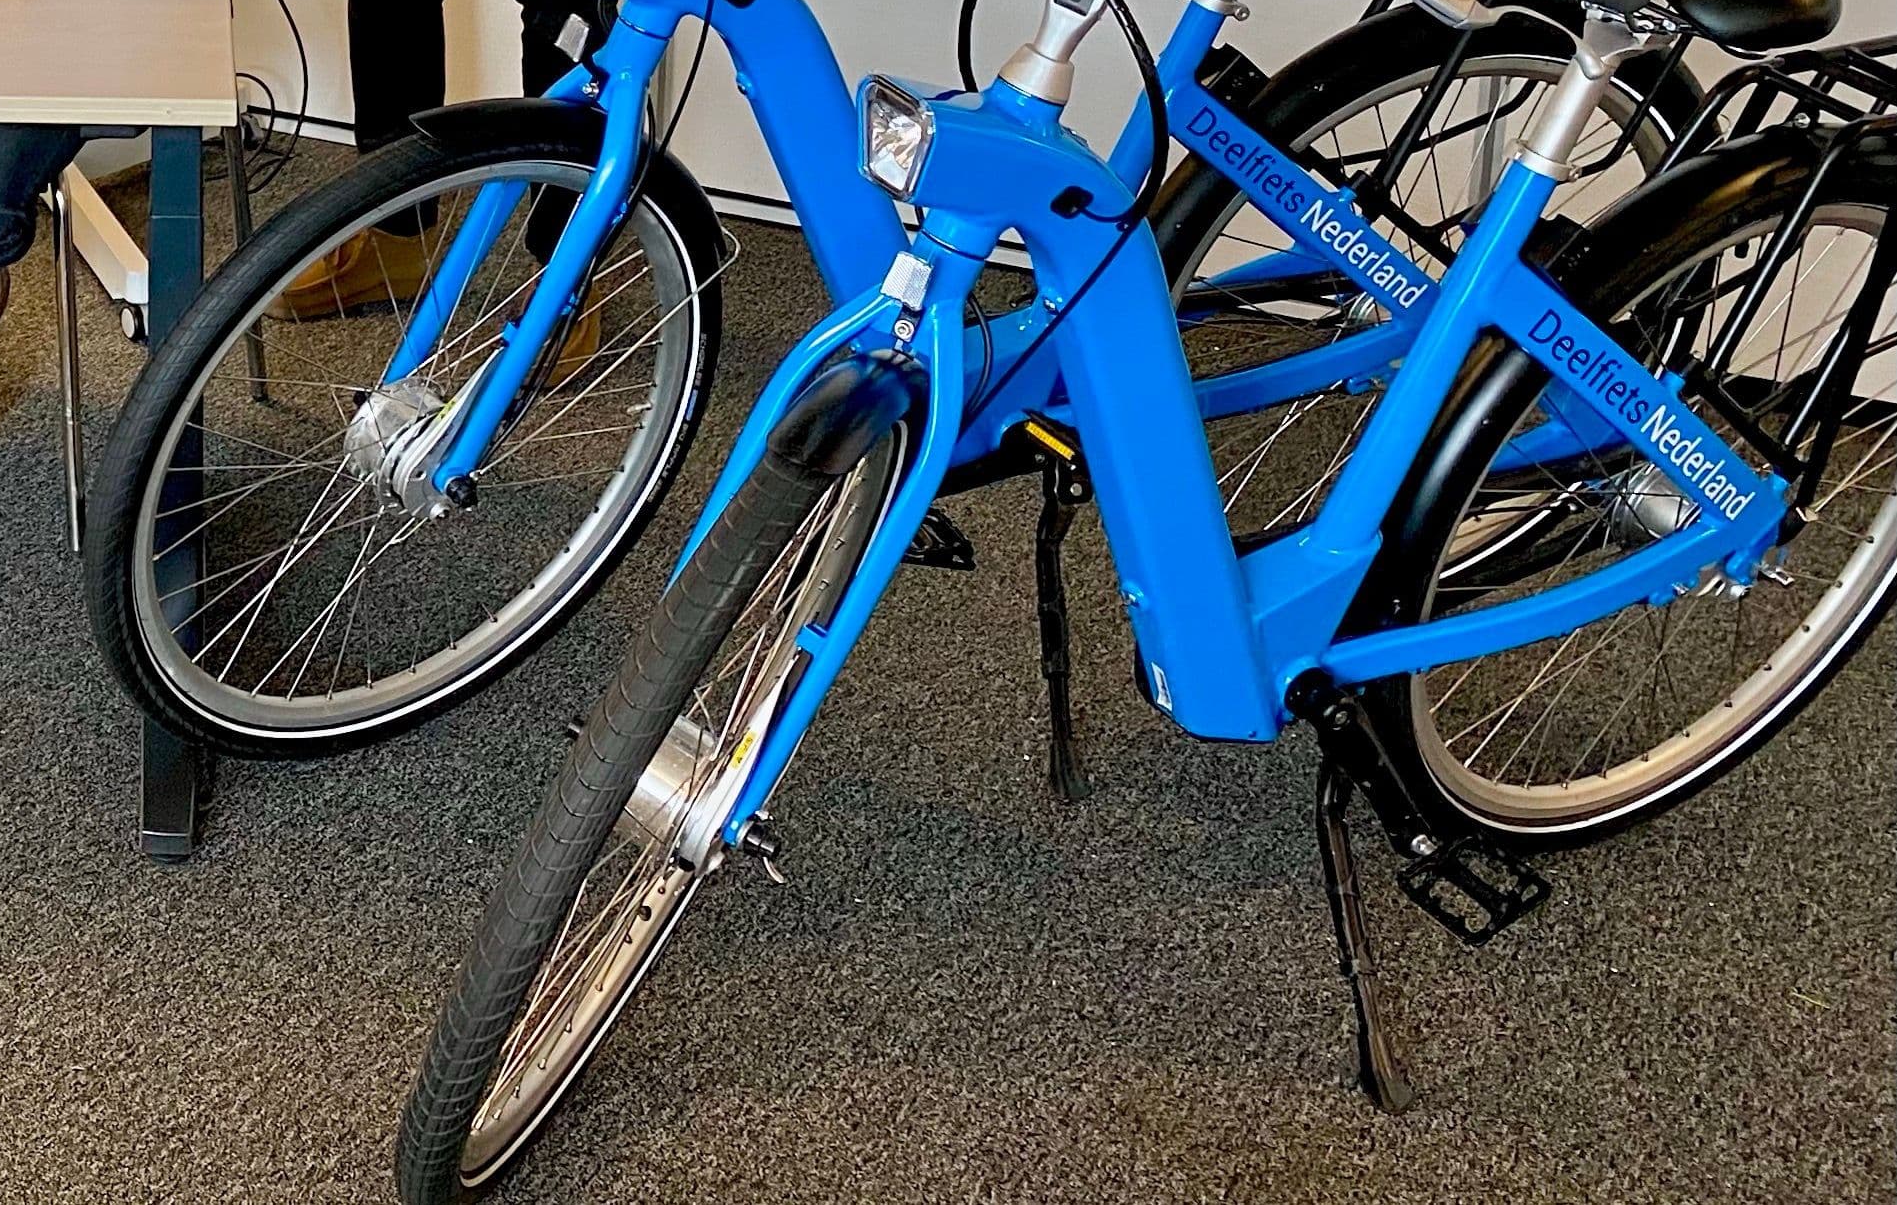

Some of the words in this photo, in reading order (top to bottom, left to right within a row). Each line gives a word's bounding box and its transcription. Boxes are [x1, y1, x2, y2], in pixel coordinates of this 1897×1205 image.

[1185, 105, 1305, 213] Deelfiets
[1299, 198, 1429, 309] Nederland
[1528, 308, 1650, 425] Deelfiets
[1640, 403, 1756, 521] Nederland
